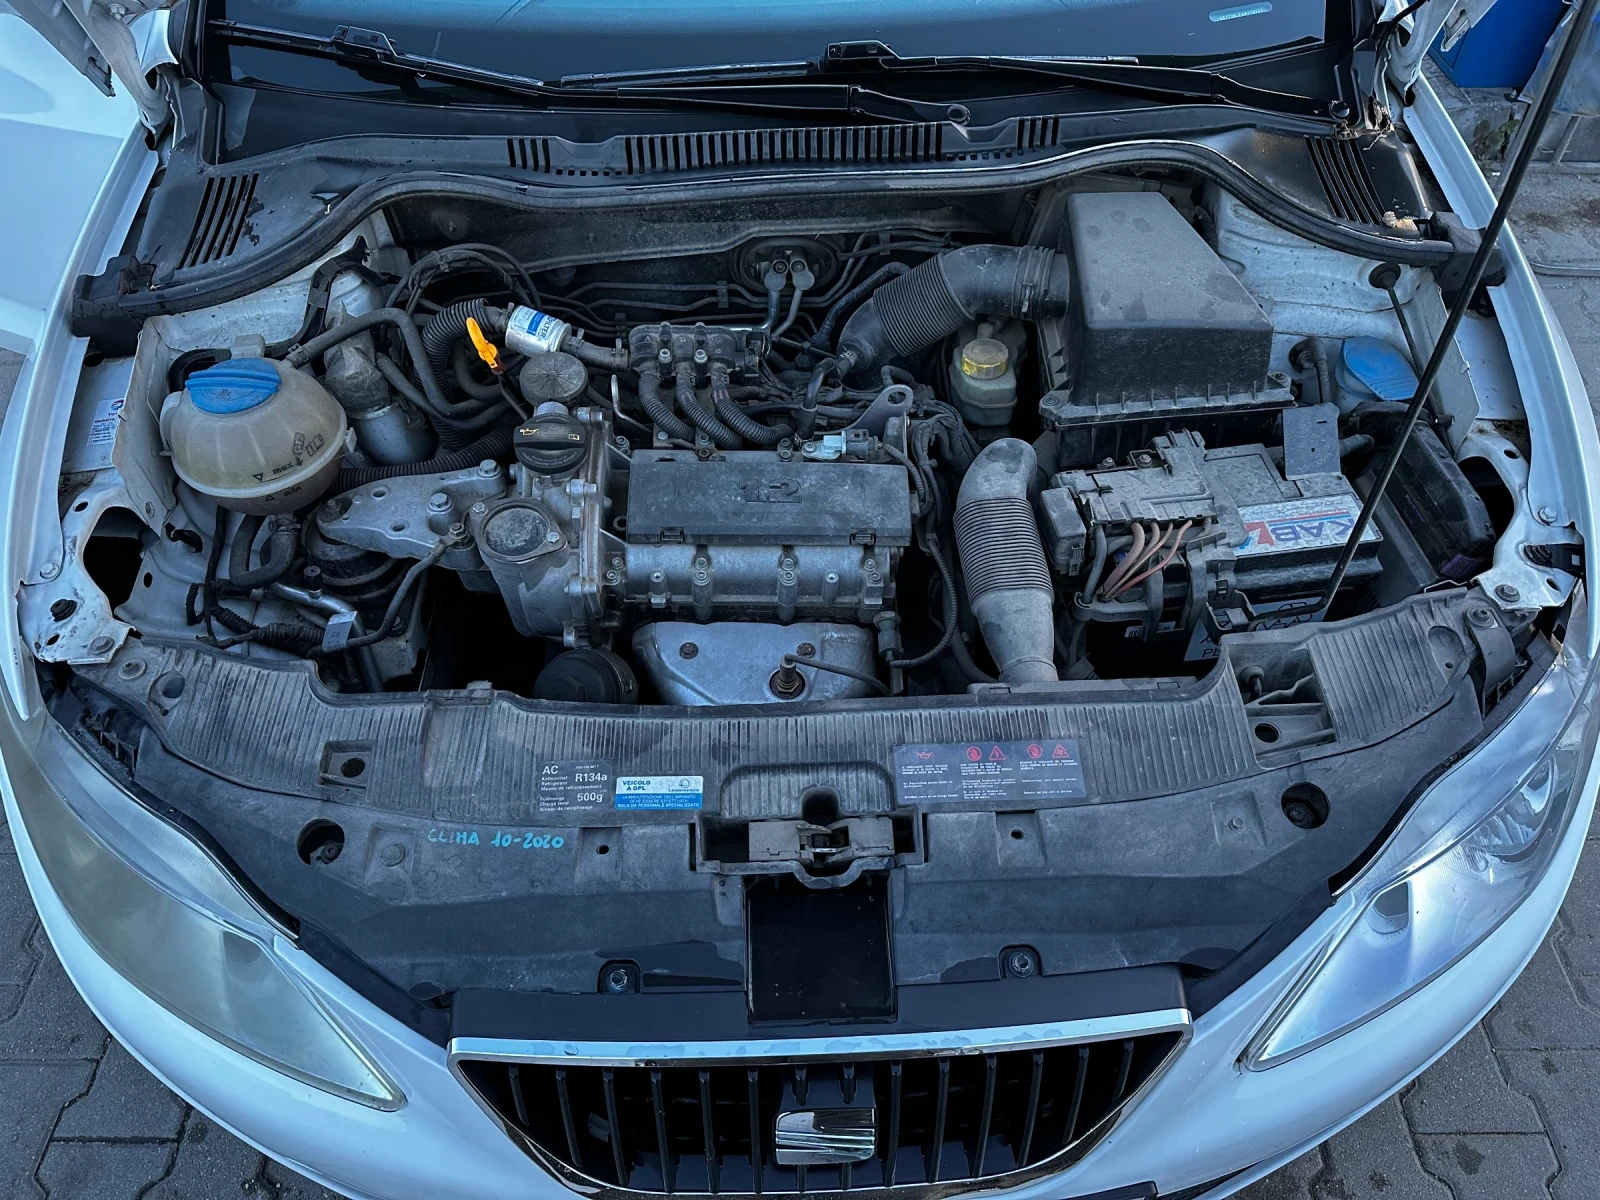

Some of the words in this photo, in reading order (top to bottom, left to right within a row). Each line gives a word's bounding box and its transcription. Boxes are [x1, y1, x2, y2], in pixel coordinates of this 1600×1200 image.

[272, 462, 294, 475] max
[283, 485, 302, 497] min
[542, 765, 559, 775] AC
[575, 772, 608, 782] R134a
[576, 792, 603, 803] 500g
[427, 829, 480, 846] CLIMA
[490, 830, 564, 849] 10-2020
